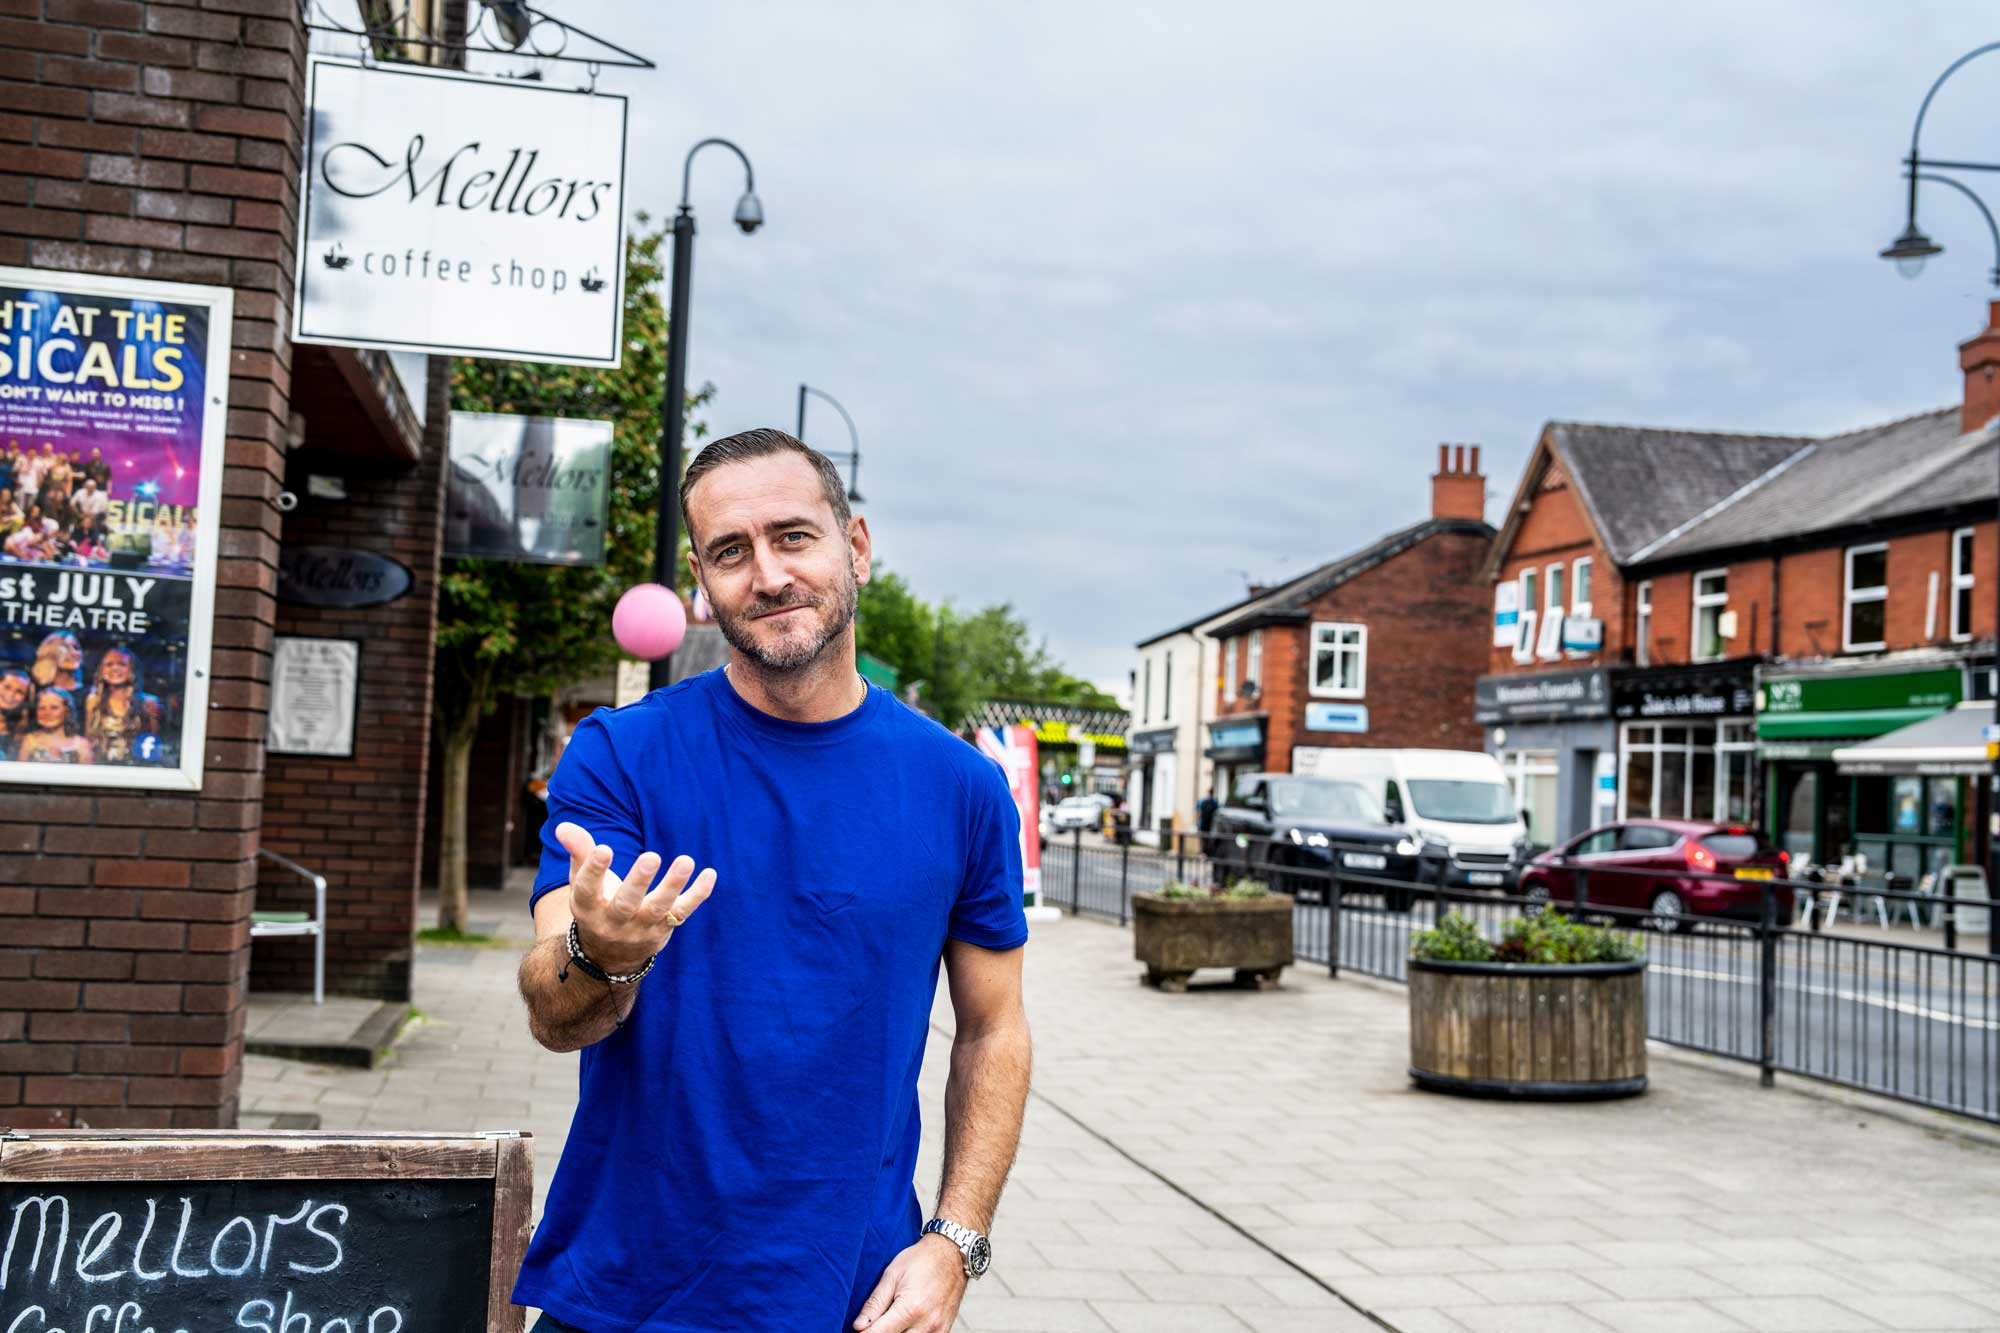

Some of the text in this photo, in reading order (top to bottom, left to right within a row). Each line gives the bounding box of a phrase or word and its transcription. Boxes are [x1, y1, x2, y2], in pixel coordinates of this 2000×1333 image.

[321, 133, 612, 222] Mellors
[364, 249, 567, 295] coffee shop
[51, 305, 101, 337] AT
[110, 310, 186, 344] THE
[45, 388, 98, 405] WANT
[102, 392, 126, 407] TO
[130, 396, 174, 411] MISS
[107, 500, 197, 529] SICAL
[0, 571, 156, 609] st JULY
[3, 601, 148, 633] THEATRE
